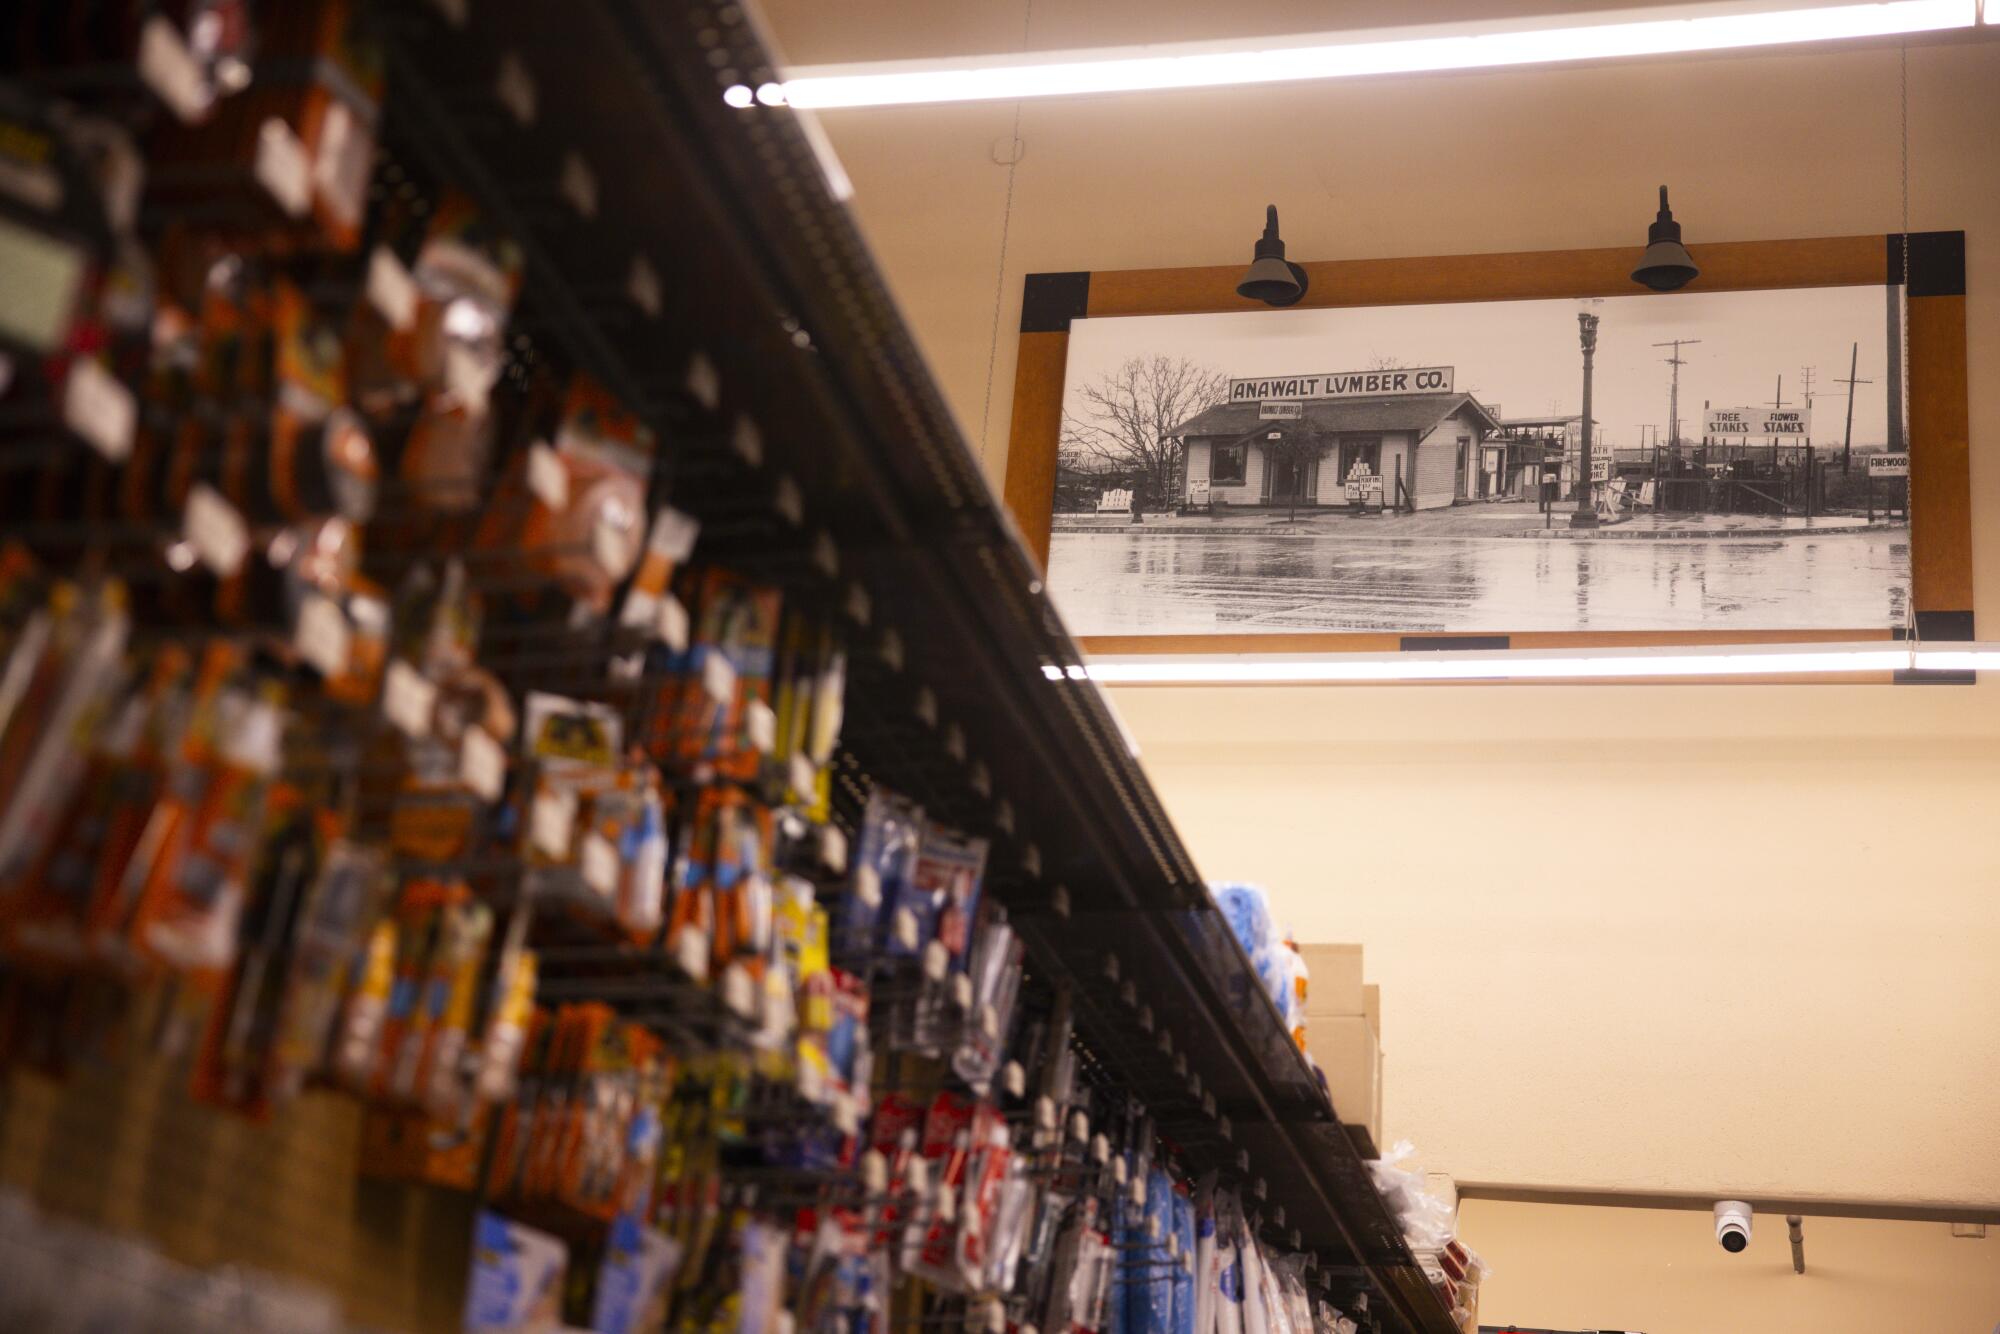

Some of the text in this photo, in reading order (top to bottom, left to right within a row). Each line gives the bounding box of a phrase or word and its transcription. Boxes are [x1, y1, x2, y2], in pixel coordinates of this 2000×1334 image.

[1233, 378, 1320, 399] ANAWALT
[1415, 371, 1448, 390] CO.
[1715, 413, 1741, 422] TREE
[1770, 413, 1800, 422] FLOWER
[1709, 422, 1749, 433] STAKES
[1763, 422, 1805, 433] STAKES
[1870, 457, 1908, 467] FIREWOOD
